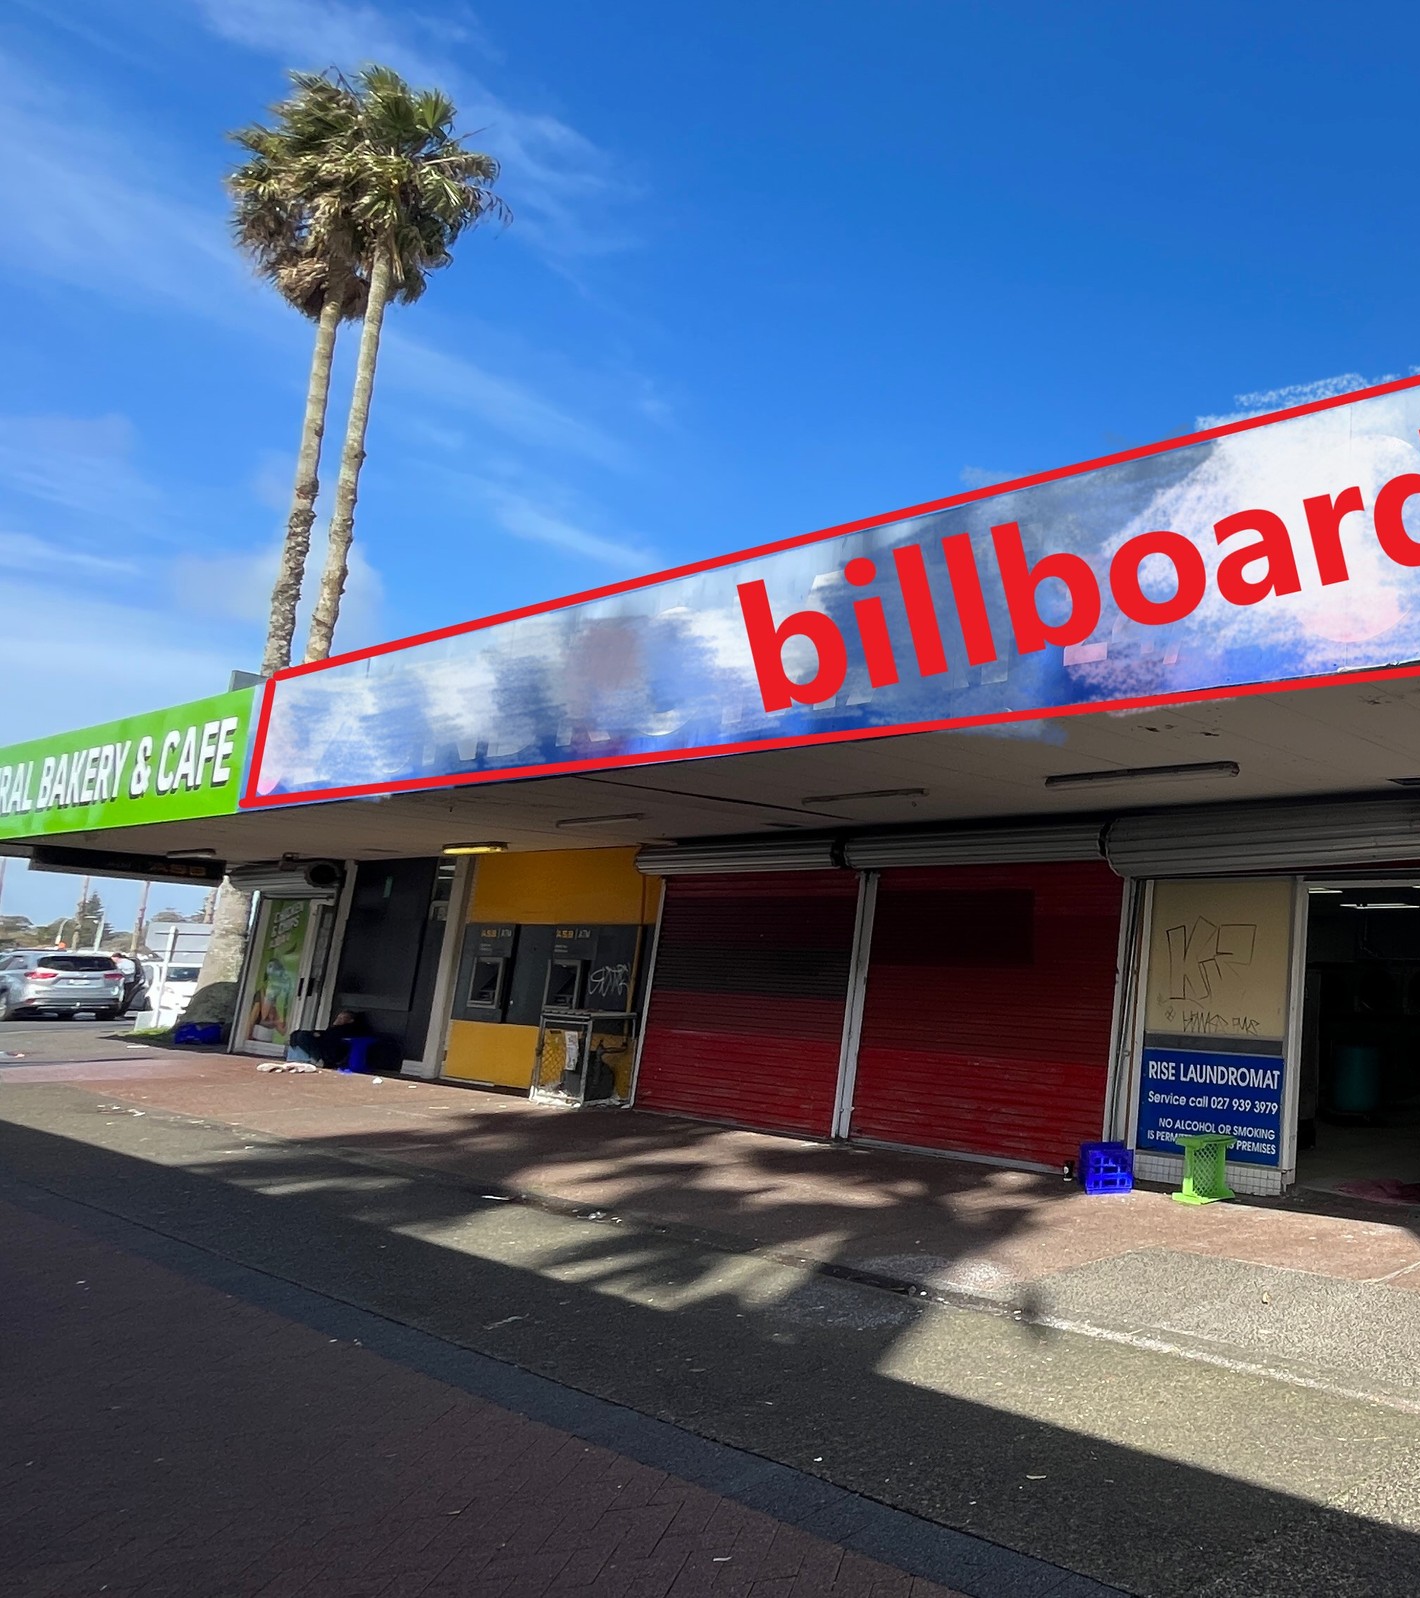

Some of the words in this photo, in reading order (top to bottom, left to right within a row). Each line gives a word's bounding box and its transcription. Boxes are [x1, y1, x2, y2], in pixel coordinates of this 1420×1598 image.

[37, 740, 131, 812] BAKERY
[129, 736, 153, 799] &
[156, 717, 239, 796] CAFE
[556, 929, 574, 939] ASB
[1148, 1060, 1176, 1081] RISE
[1180, 1063, 1281, 1090] LAUNDROMAT
[1147, 1090, 1187, 1106] Service
[1189, 1096, 1208, 1108] call
[1210, 1096, 1230, 1110] 027
[1232, 1099, 1251, 1112] 939
[1253, 1100, 1278, 1115] 3979
[1158, 1117, 1173, 1129] NO
[1174, 1120, 1216, 1133] ALCOHOL
[1217, 1124, 1232, 1135] OR
[1232, 1125, 1276, 1140] SMOKING
[1147, 1129, 1155, 1140] IS
[1236, 1140, 1277, 1155] PREMISES
